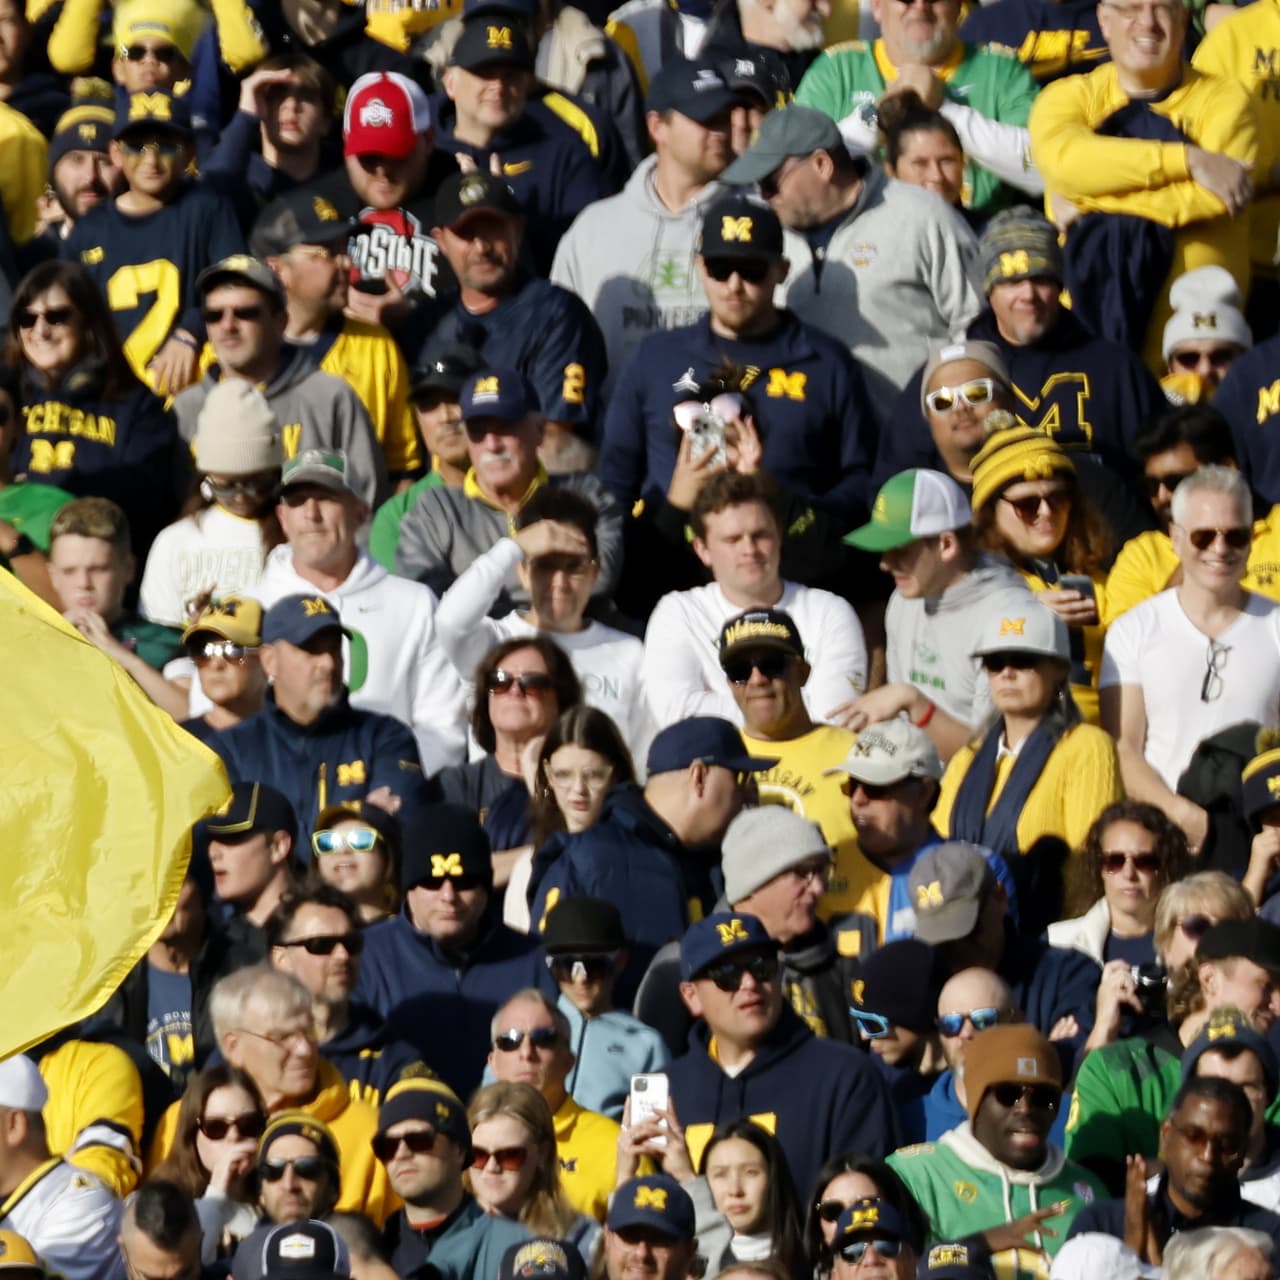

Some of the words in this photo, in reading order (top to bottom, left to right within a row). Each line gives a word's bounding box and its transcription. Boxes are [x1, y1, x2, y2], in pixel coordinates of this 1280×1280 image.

[487, 25, 513, 49] M
[128, 91, 171, 118] M
[721, 215, 752, 242] M
[999, 249, 1029, 277] M
[1194, 313, 1217, 329] M
[766, 368, 808, 401] M
[23, 400, 117, 446] CHIGAN
[302, 598, 329, 616] M
[1000, 617, 1026, 636] M
[338, 760, 365, 786] M
[431, 854, 462, 876] M
[917, 880, 944, 907] M
[715, 920, 748, 945] M
[636, 1186, 667, 1208] M
